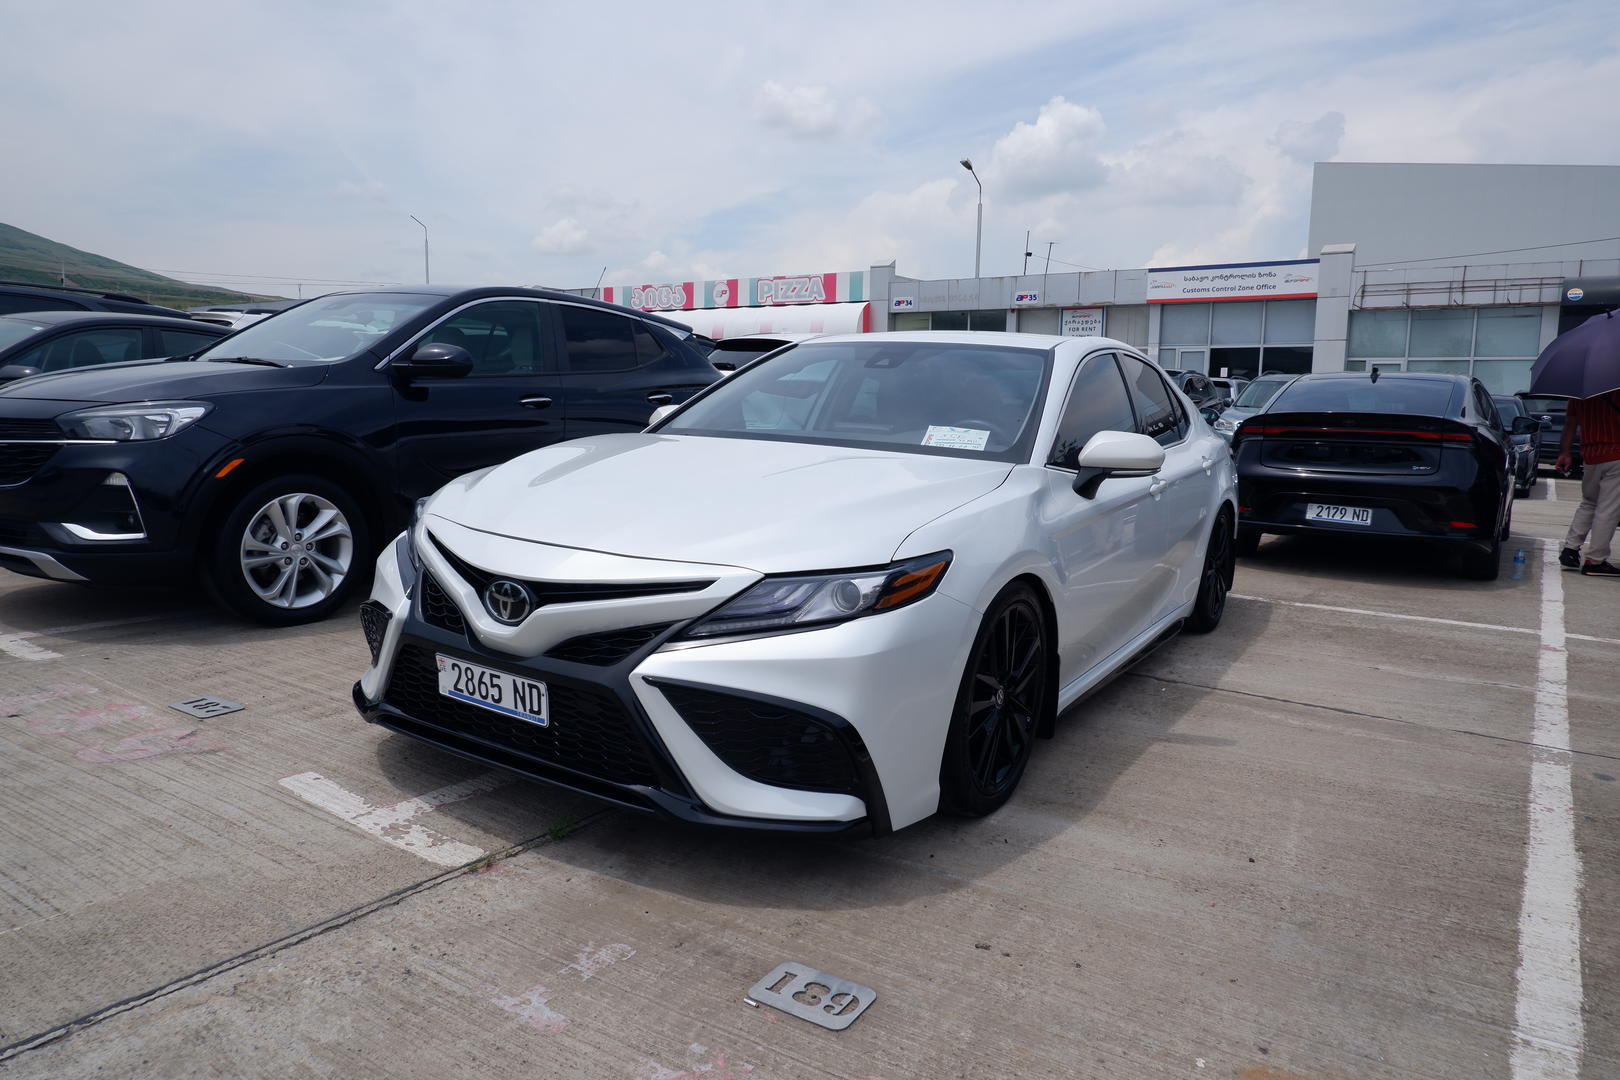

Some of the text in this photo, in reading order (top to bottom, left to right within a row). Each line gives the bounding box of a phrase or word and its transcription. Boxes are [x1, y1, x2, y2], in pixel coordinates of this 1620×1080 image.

[758, 277, 824, 302] PIZZA
[1028, 294, 1037, 302] 35
[905, 299, 913, 307] 34
[1316, 504, 1370, 522] 2179 ND
[451, 663, 542, 716] 2865 ND
[765, 971, 860, 1016] 189
